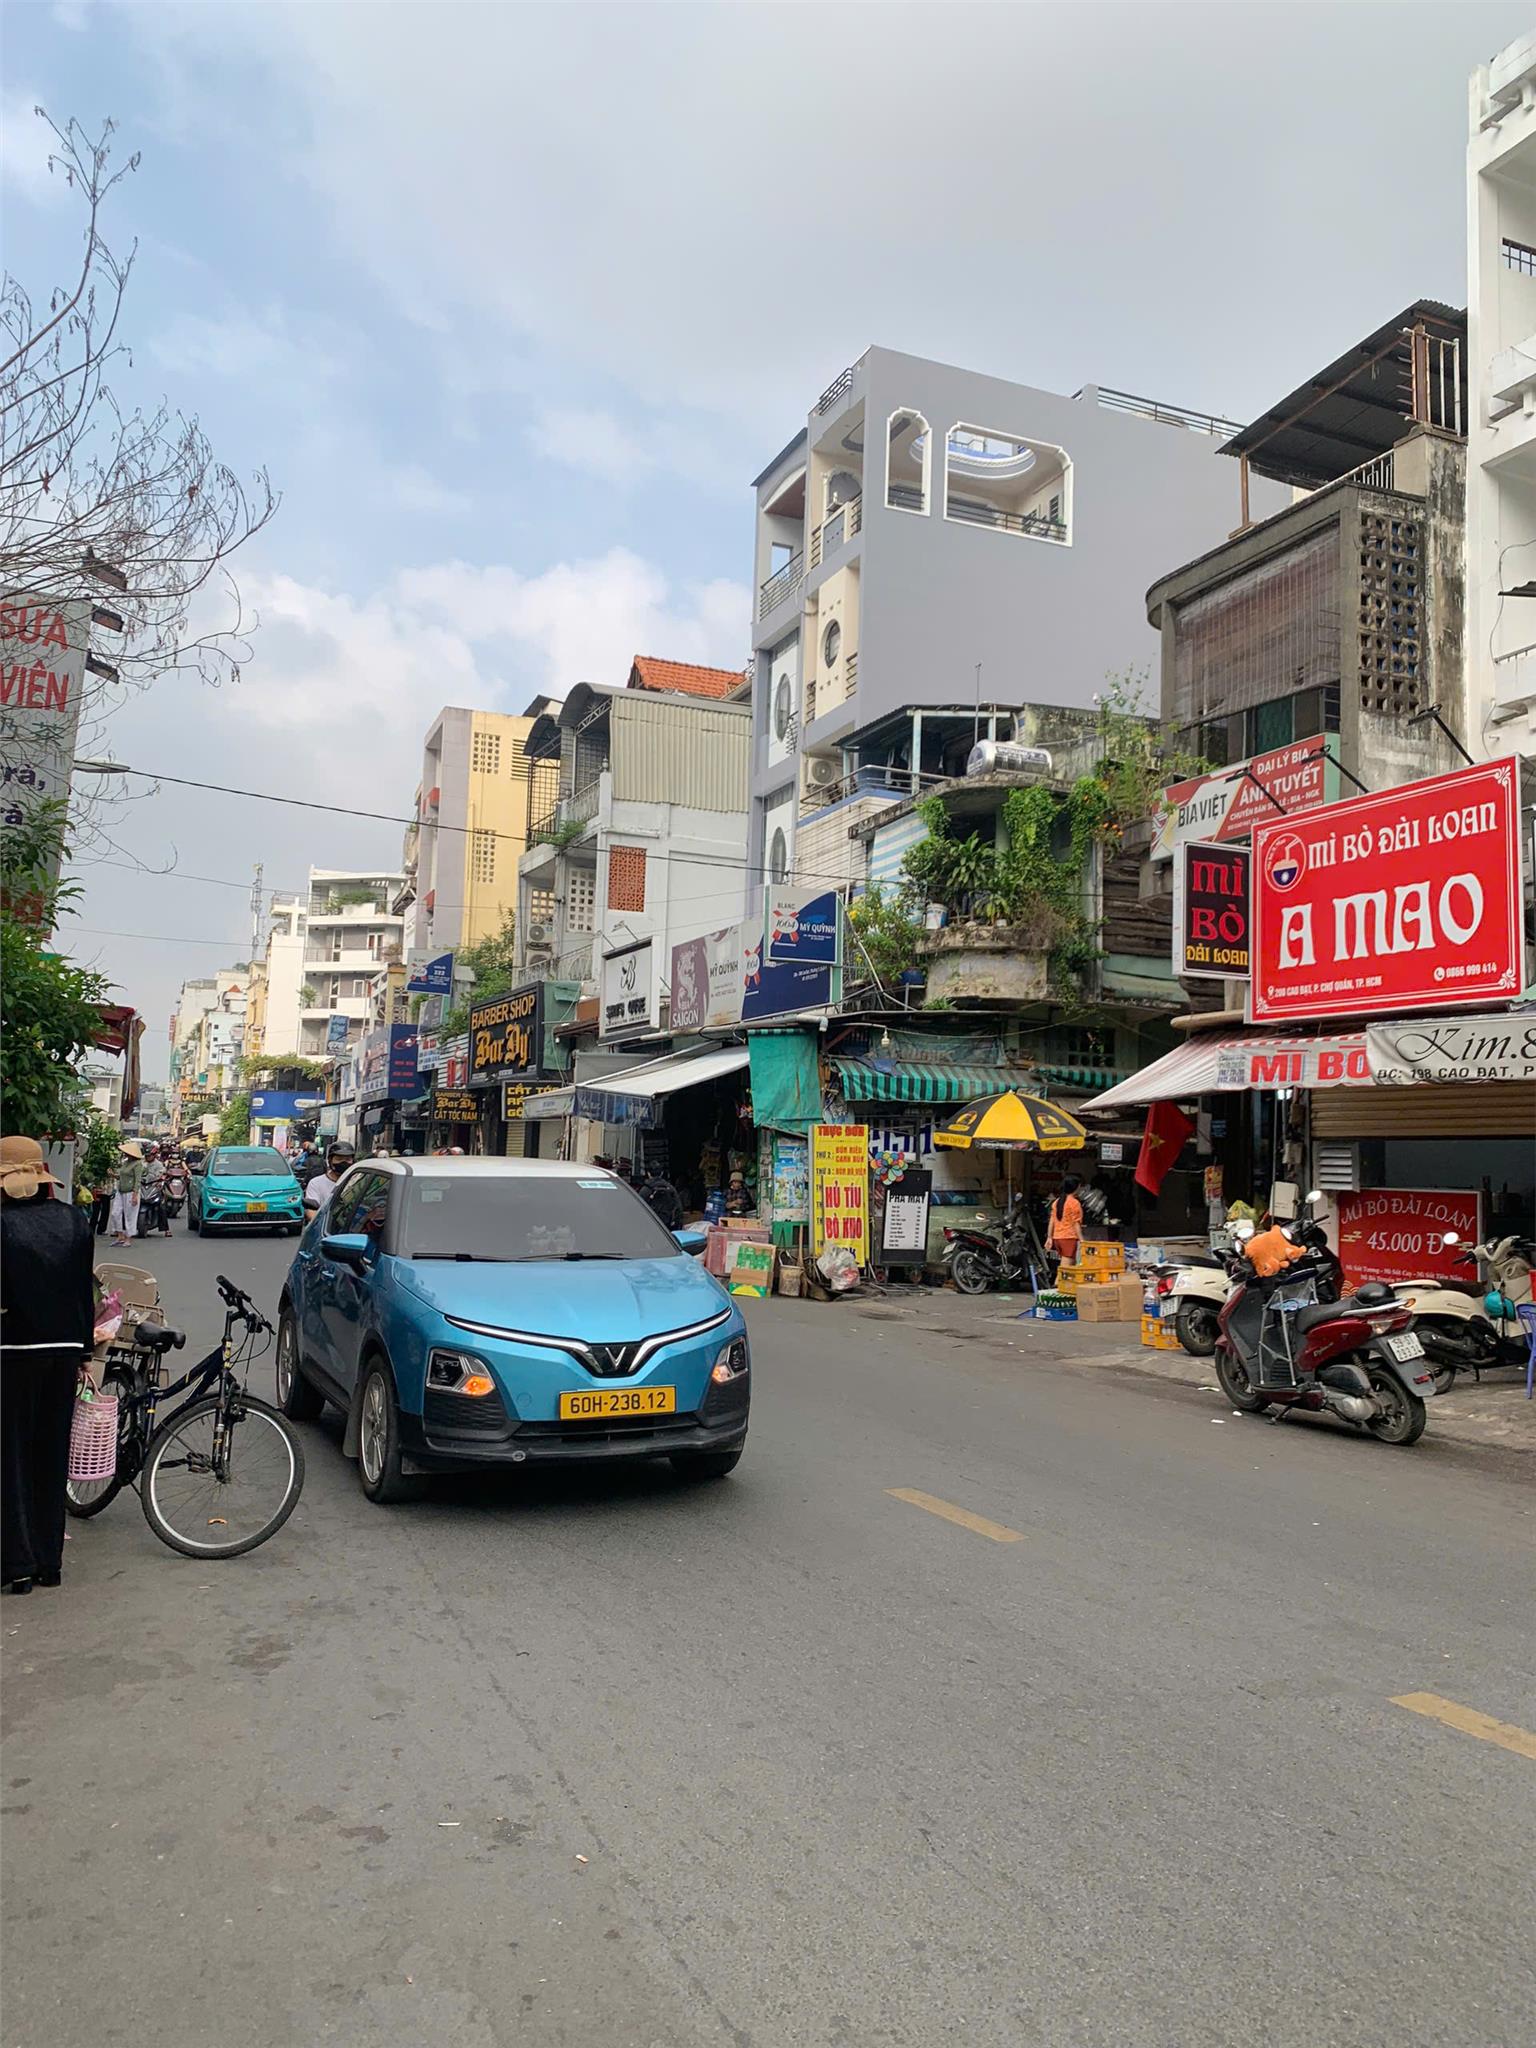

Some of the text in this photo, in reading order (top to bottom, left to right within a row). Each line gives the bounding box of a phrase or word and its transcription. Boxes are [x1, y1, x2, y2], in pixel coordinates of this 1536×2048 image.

[1277, 754, 1288, 770] LÝ
[1291, 748, 1309, 765] BIA
[1273, 763, 1320, 796] TUYẾT
[1308, 832, 1336, 870] MÌ
[1342, 824, 1372, 863] BÒ
[1378, 816, 1420, 854] ĐÀI
[1428, 802, 1498, 844] LOAN
[1191, 858, 1244, 896] MÌ
[1191, 904, 1245, 943] BÒ
[1278, 872, 1484, 971] A MAO
[1213, 948, 1249, 966] LOAN
[472, 994, 536, 1030] BARBER SHOP
[1411, 1068, 1432, 1079] 198
[1438, 1067, 1470, 1079] CAO
[825, 1213, 840, 1239] BÒ
[843, 1217, 863, 1239] KHO
[1366, 1195, 1388, 1216] BÒ
[1392, 1194, 1422, 1215] ĐÀI
[1424, 1202, 1476, 1231] LOAN
[1367, 1231, 1444, 1255] 45.000 Đ
[570, 1391, 666, 1414] 60H-238.12
